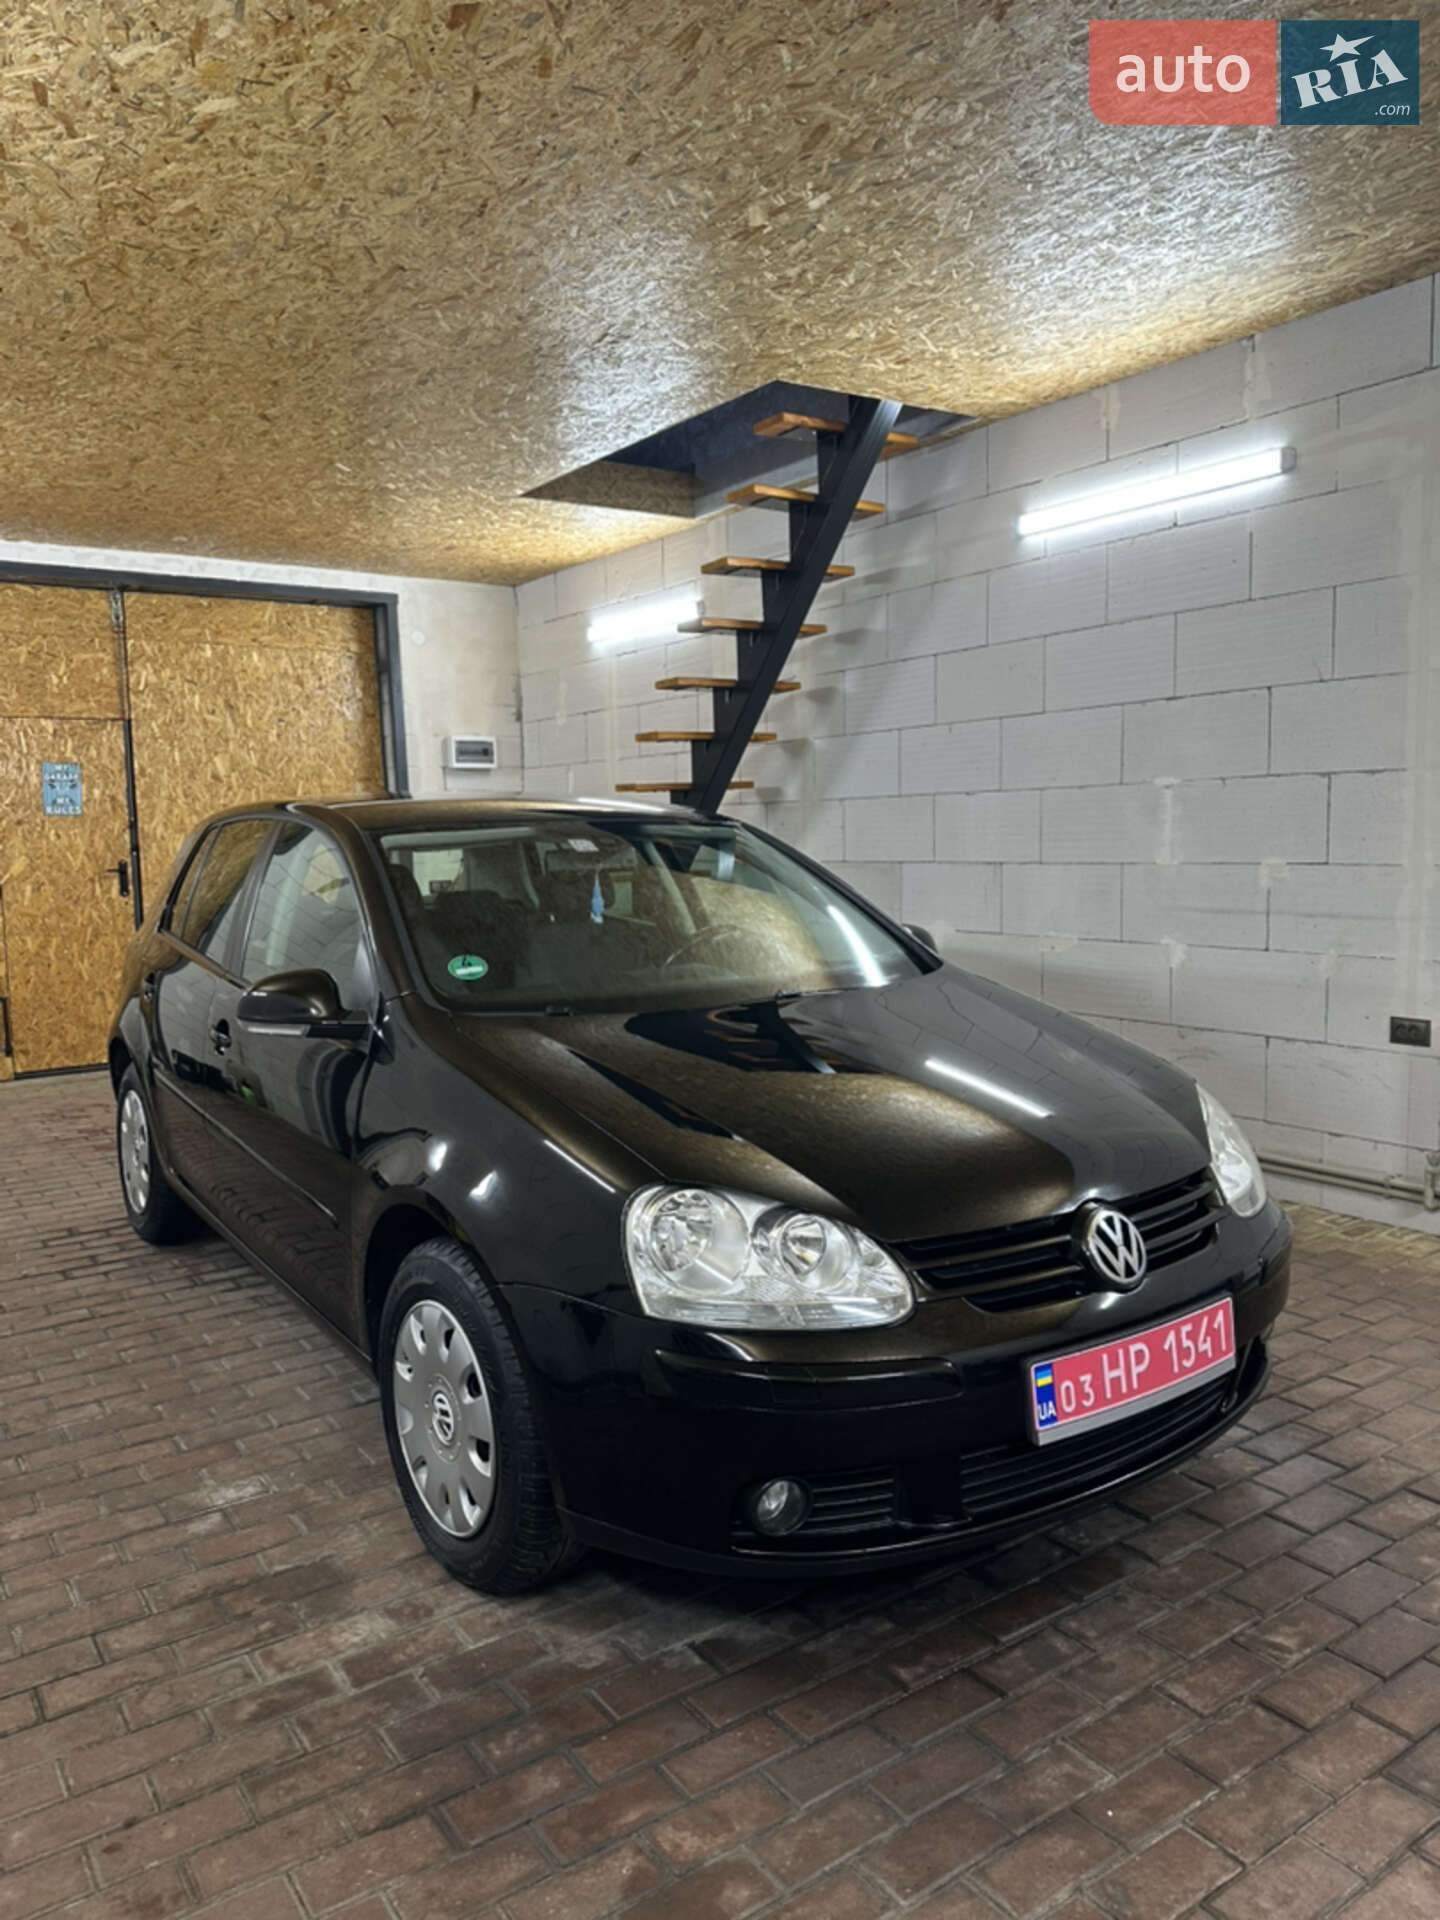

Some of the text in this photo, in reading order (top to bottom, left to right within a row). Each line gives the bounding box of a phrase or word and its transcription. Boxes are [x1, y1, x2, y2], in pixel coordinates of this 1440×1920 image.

[45, 805, 82, 815] RULES
[1037, 1309, 1227, 1421] UA 03 HP 1541
